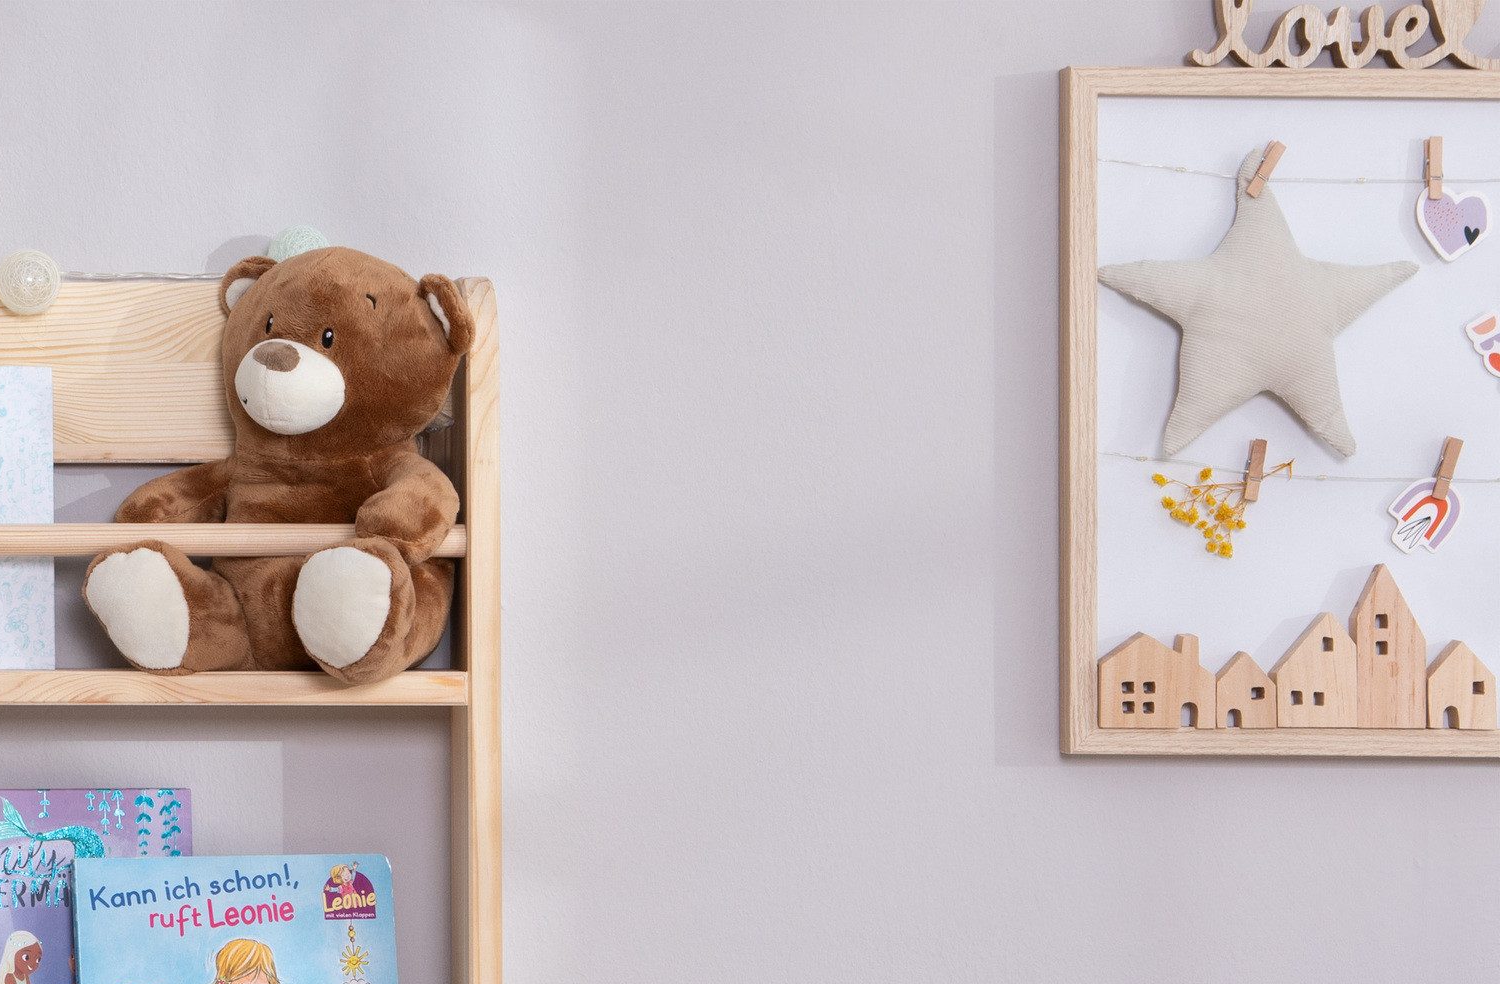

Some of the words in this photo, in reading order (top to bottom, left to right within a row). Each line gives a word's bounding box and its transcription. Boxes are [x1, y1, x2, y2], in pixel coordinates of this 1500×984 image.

[89, 885, 157, 911] Kann
[164, 876, 201, 901] ich
[209, 863, 299, 896] schon!,
[322, 890, 377, 912] Leonie
[149, 904, 203, 938] ruft
[207, 894, 295, 929] Leonie
